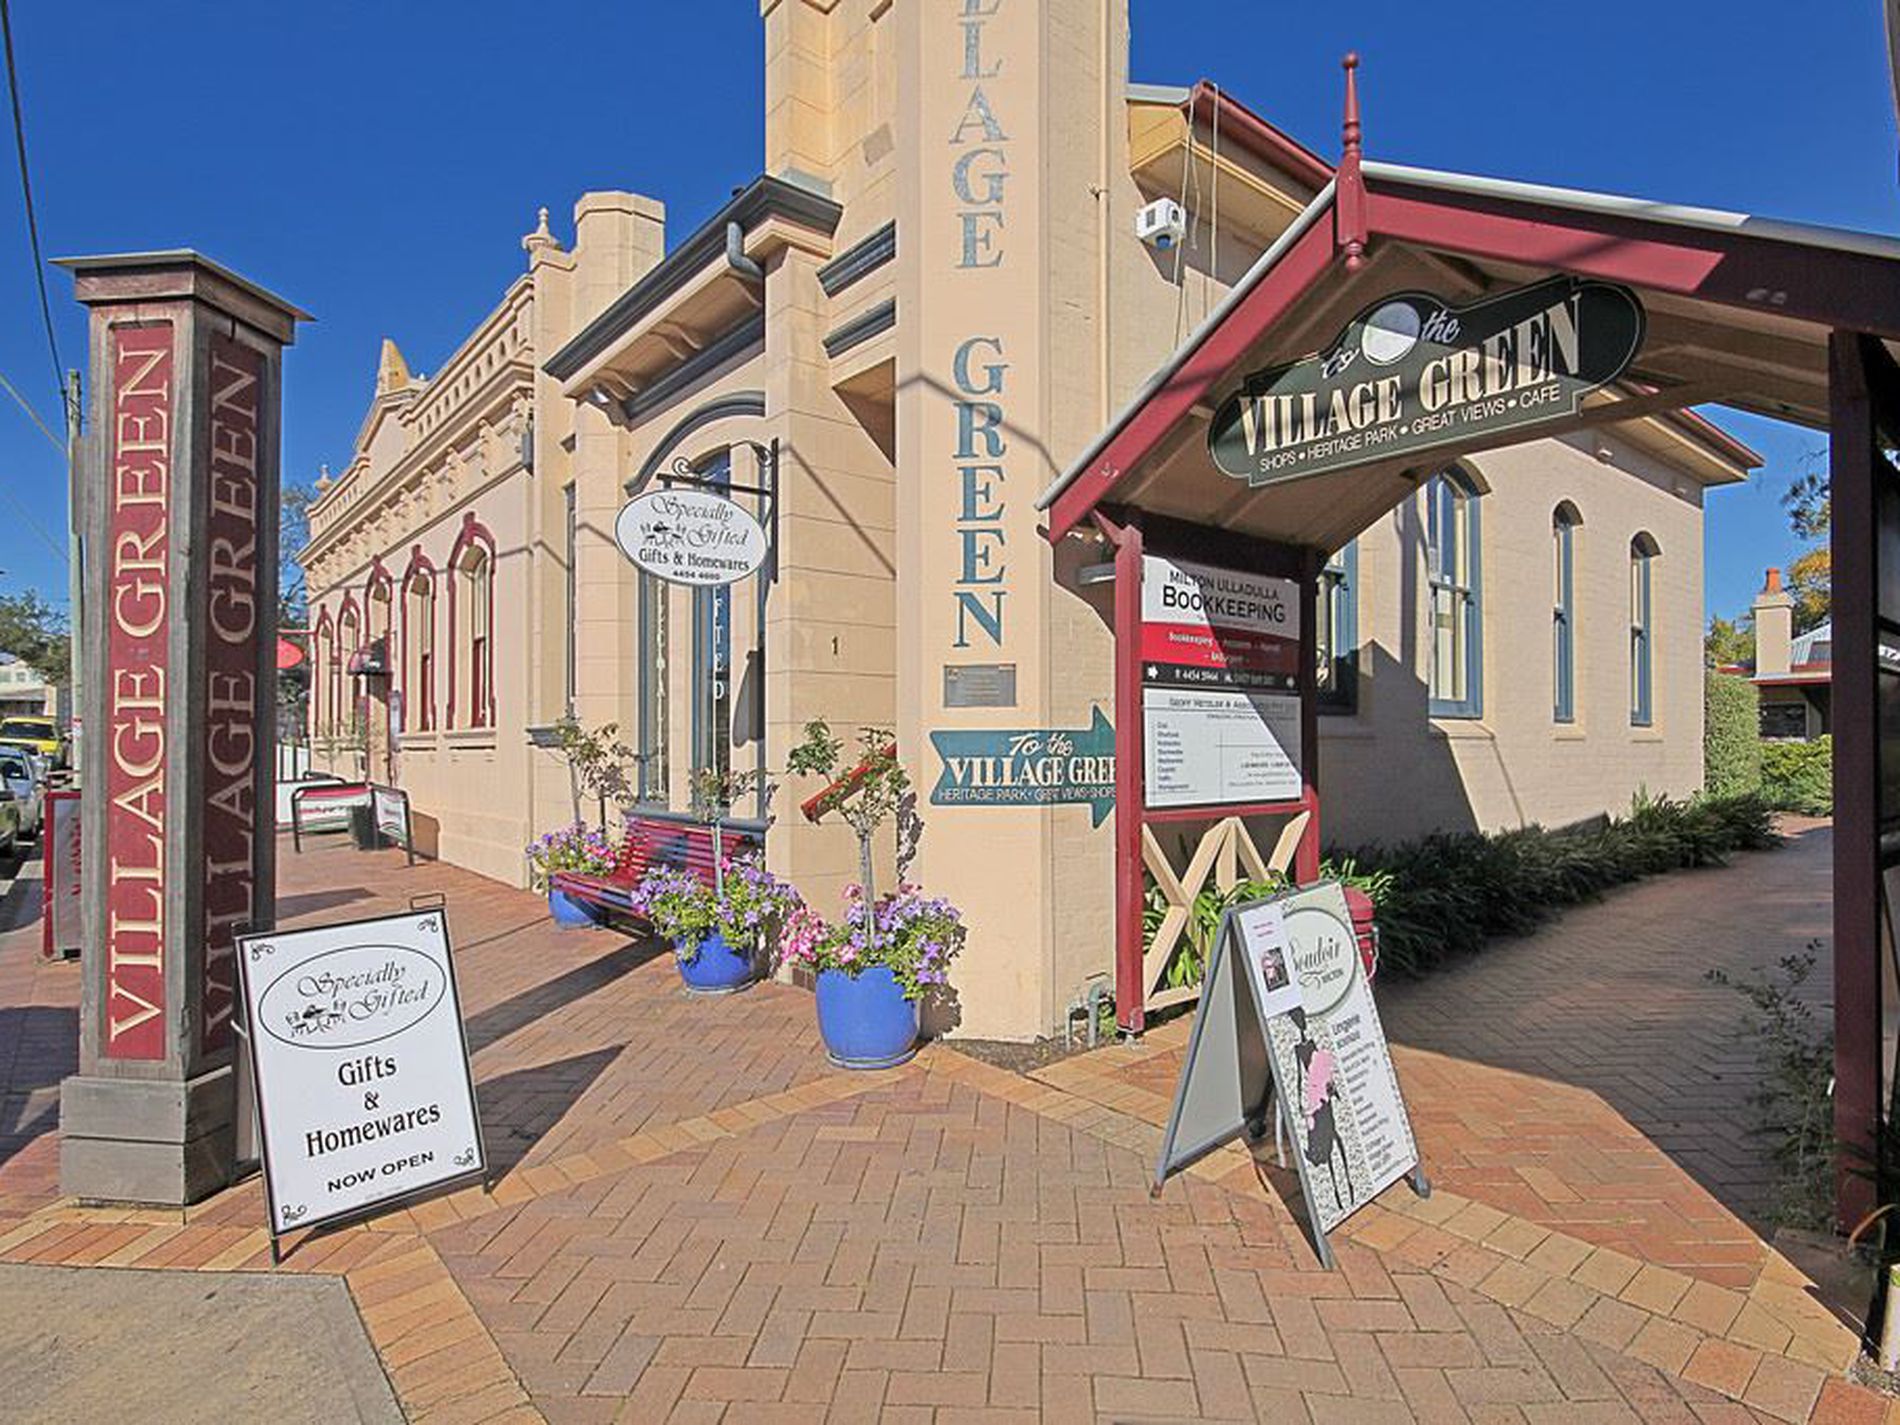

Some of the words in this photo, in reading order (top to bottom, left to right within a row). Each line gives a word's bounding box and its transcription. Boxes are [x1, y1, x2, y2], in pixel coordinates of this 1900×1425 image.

[1421, 309, 1460, 343] the
[1239, 375, 1404, 456] VILLAGE
[1419, 293, 1581, 412] GREEN
[1259, 450, 1296, 473] SHOPS
[1307, 438, 1362, 460] HERITAGE
[1364, 425, 1398, 447] PARK
[1412, 411, 1456, 435] GREAT
[1461, 399, 1506, 423] VIEWS
[1519, 384, 1561, 409] CAFE
[114, 344, 169, 637] GREEN
[210, 354, 258, 645] GREEN
[952, 337, 1009, 648] GREEN
[650, 495, 733, 528] Specially
[687, 523, 749, 549] Gifted
[639, 548, 669, 565] Gifts
[673, 552, 683, 567] &
[687, 552, 750, 571] Homewares
[1169, 569, 1215, 589] MILTON
[1217, 575, 1279, 600] ULLADULLA
[1163, 584, 1285, 623] BOOKKEEPING
[831, 635, 838, 655] 1
[1009, 732, 1043, 756] To
[1047, 732, 1074, 756] the
[946, 756, 1065, 786] VILLAGE
[939, 789, 994, 801] HERITAGE
[997, 788, 1027, 801] PARK
[111, 664, 166, 1042] VILLAGE
[205, 670, 256, 1035] VILLAGE
[297, 961, 406, 998] Specially
[349, 980, 429, 1020] Gifted
[338, 1055, 397, 1087] Gifts
[363, 1091, 379, 1111] &
[306, 1102, 441, 1158] Homewares
[327, 1167, 376, 1193] NOW
[381, 1150, 434, 1176] OPEN
